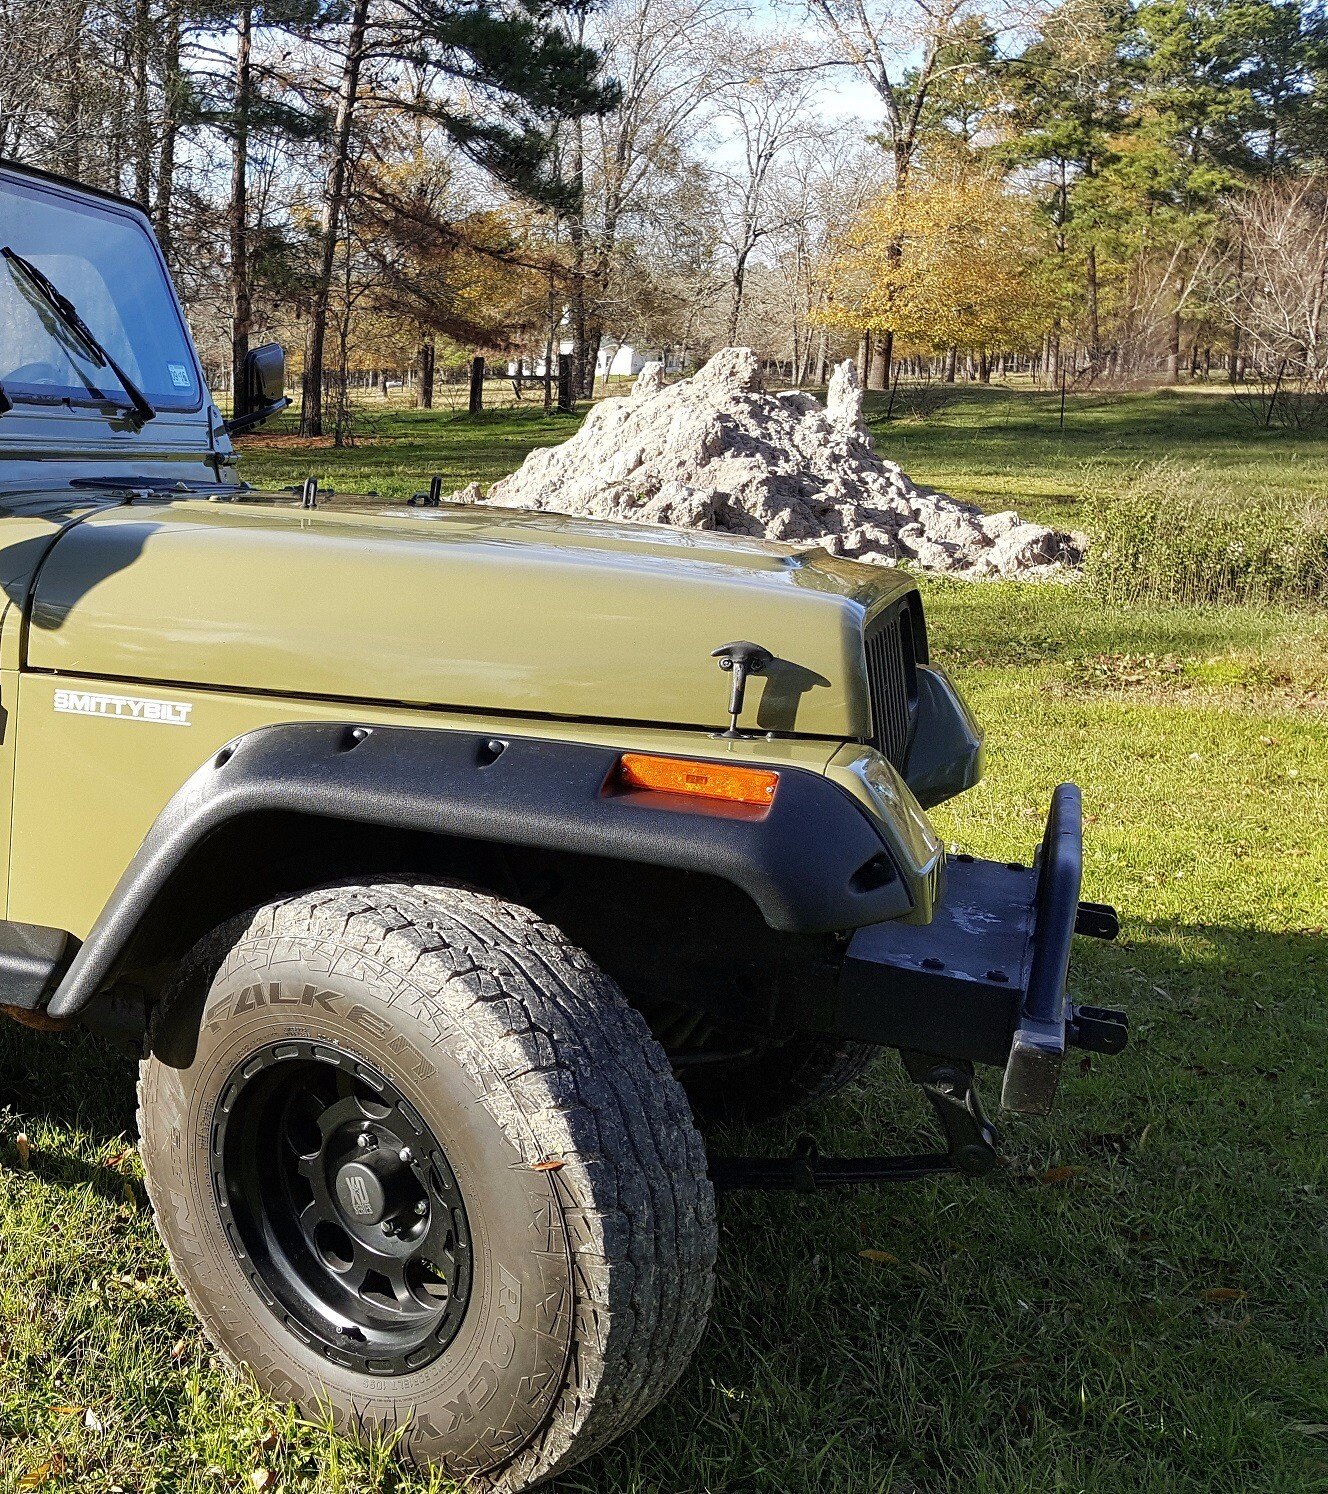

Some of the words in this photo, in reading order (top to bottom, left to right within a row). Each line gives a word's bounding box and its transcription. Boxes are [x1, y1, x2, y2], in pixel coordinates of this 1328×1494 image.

[53, 690, 192, 724] SMITTYBILT
[201, 977, 439, 1082] FALKEN
[345, 1176, 369, 1206] XD
[412, 1262, 523, 1443] ROCKY
